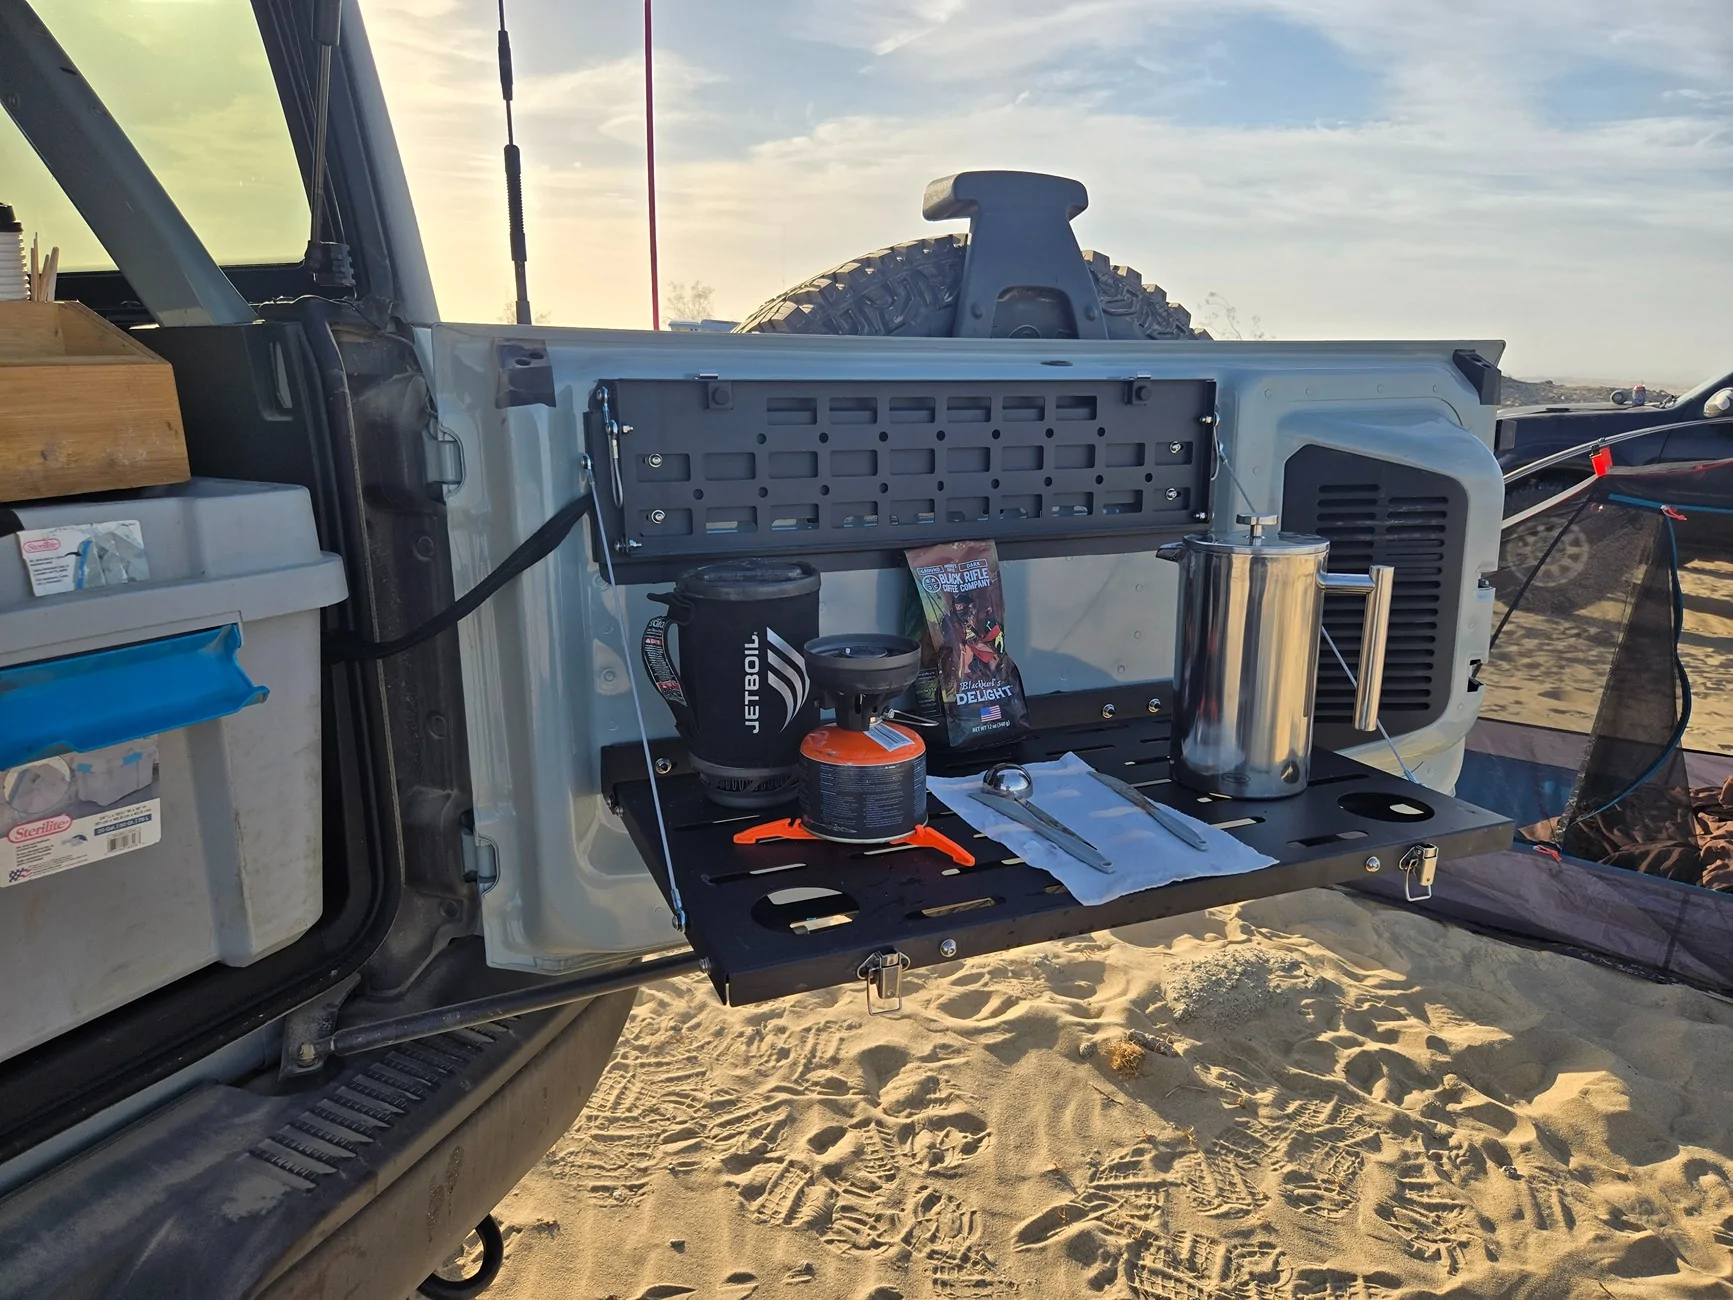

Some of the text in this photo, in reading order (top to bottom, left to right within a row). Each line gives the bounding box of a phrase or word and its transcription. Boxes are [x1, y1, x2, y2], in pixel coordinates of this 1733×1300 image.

[966, 561, 981, 569] DARK
[939, 572, 962, 585] BLACK
[964, 568, 989, 583] RIFLE
[942, 579, 990, 593] COFFEE COMPANY
[744, 633, 760, 734] JETBOIL
[955, 685, 1013, 706] DELIGHT
[15, 821, 66, 840] Sterilite
